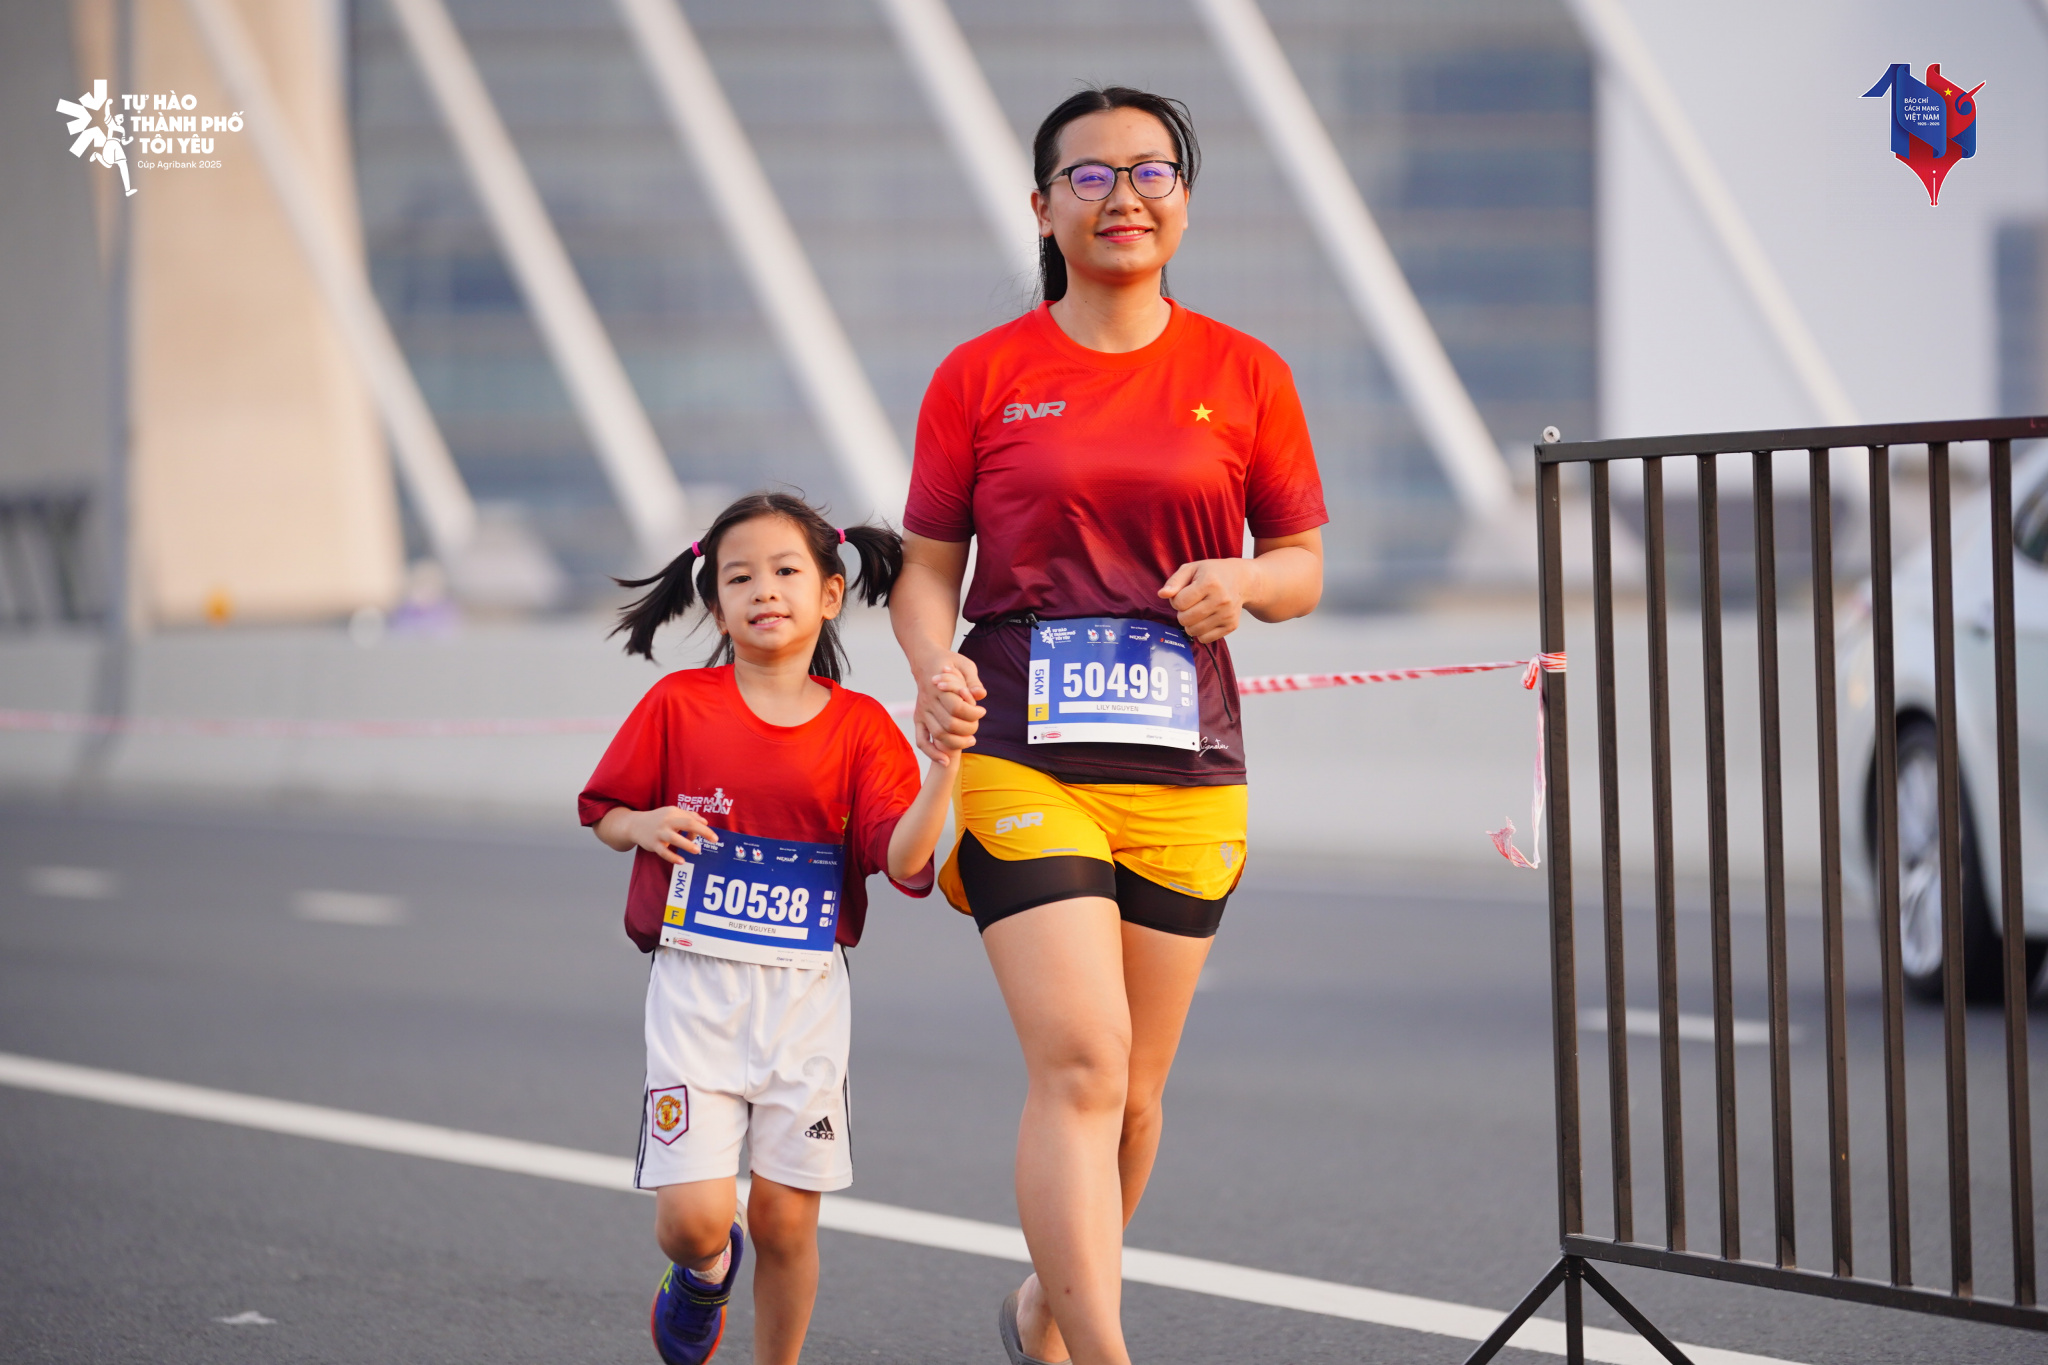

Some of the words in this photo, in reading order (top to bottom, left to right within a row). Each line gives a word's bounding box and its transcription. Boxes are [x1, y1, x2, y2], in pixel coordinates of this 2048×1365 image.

[1002, 401, 1066, 424] SNR
[1035, 669, 1044, 695] 5KM
[1063, 662, 1168, 701] 50499
[1035, 707, 1043, 717] F
[1111, 704, 1139, 713] NGUYEN
[996, 812, 1043, 834] SNR
[674, 871, 687, 898] 5KM
[703, 874, 809, 923] 50538
[671, 910, 680, 920] F
[728, 921, 747, 930] RUBY
[748, 924, 777, 934] NGUYEN
